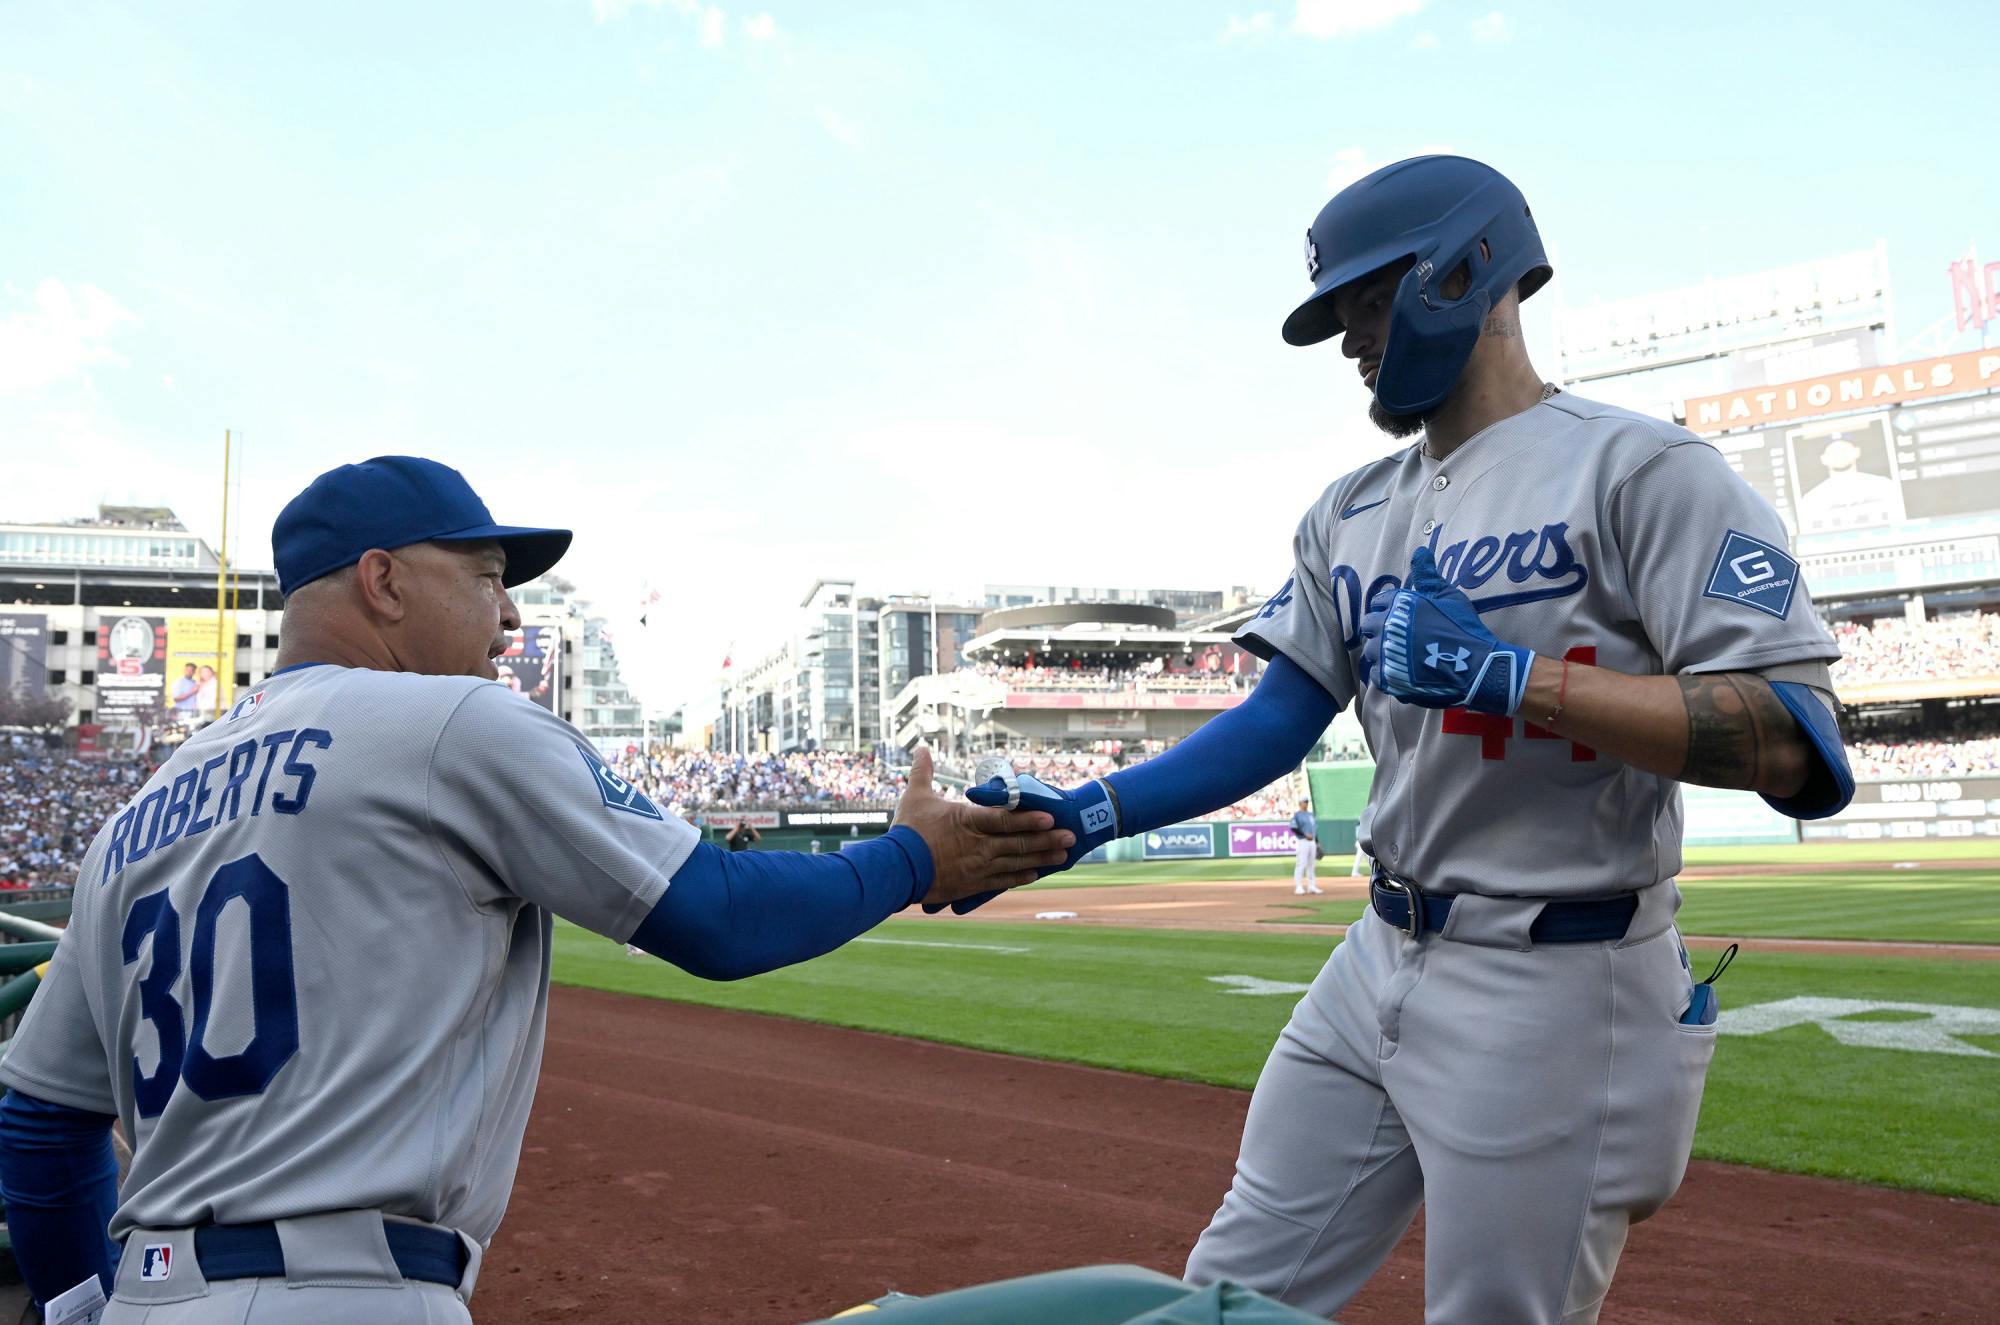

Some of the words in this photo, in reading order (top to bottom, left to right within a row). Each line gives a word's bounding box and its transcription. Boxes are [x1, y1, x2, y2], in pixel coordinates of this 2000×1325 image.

[1699, 363, 1954, 425] NATIONALS
[1730, 550, 1775, 585] G
[1737, 579, 1790, 597] GUGGENHEIM
[102, 727, 333, 887] ROBERTS
[1162, 834, 1208, 845] VANDA
[121, 852, 299, 1119] 30
